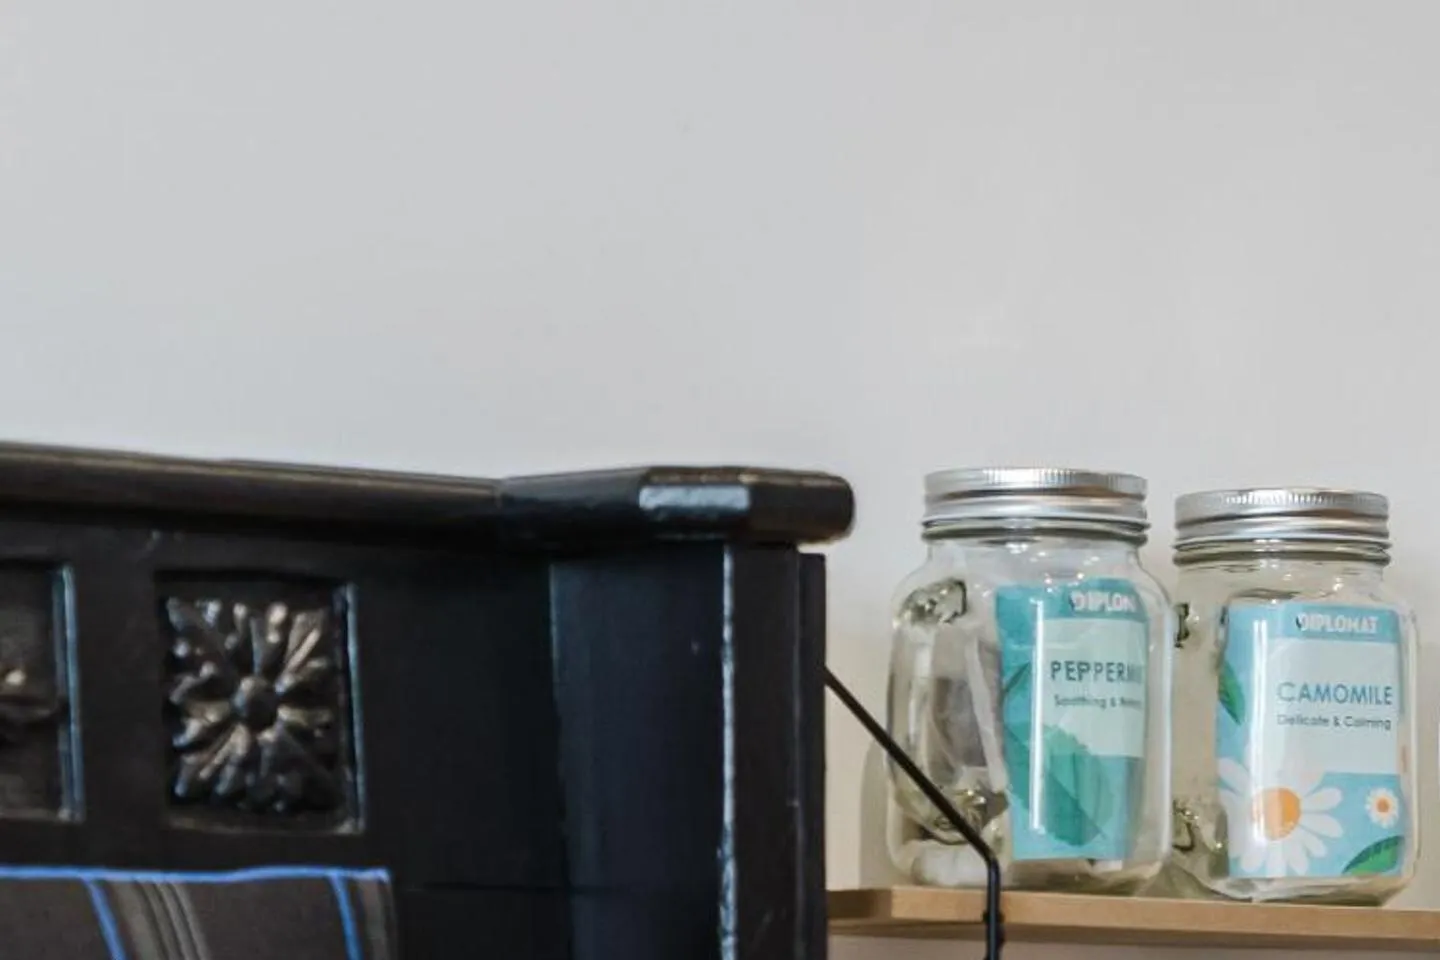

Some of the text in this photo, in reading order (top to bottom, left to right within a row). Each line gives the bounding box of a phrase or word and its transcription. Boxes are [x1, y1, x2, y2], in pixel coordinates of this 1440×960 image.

[1297, 612, 1379, 634] DIPLOMAT
[1277, 682, 1393, 706] CAMOMILE
[1277, 714, 1392, 731] Delicate & Calming
